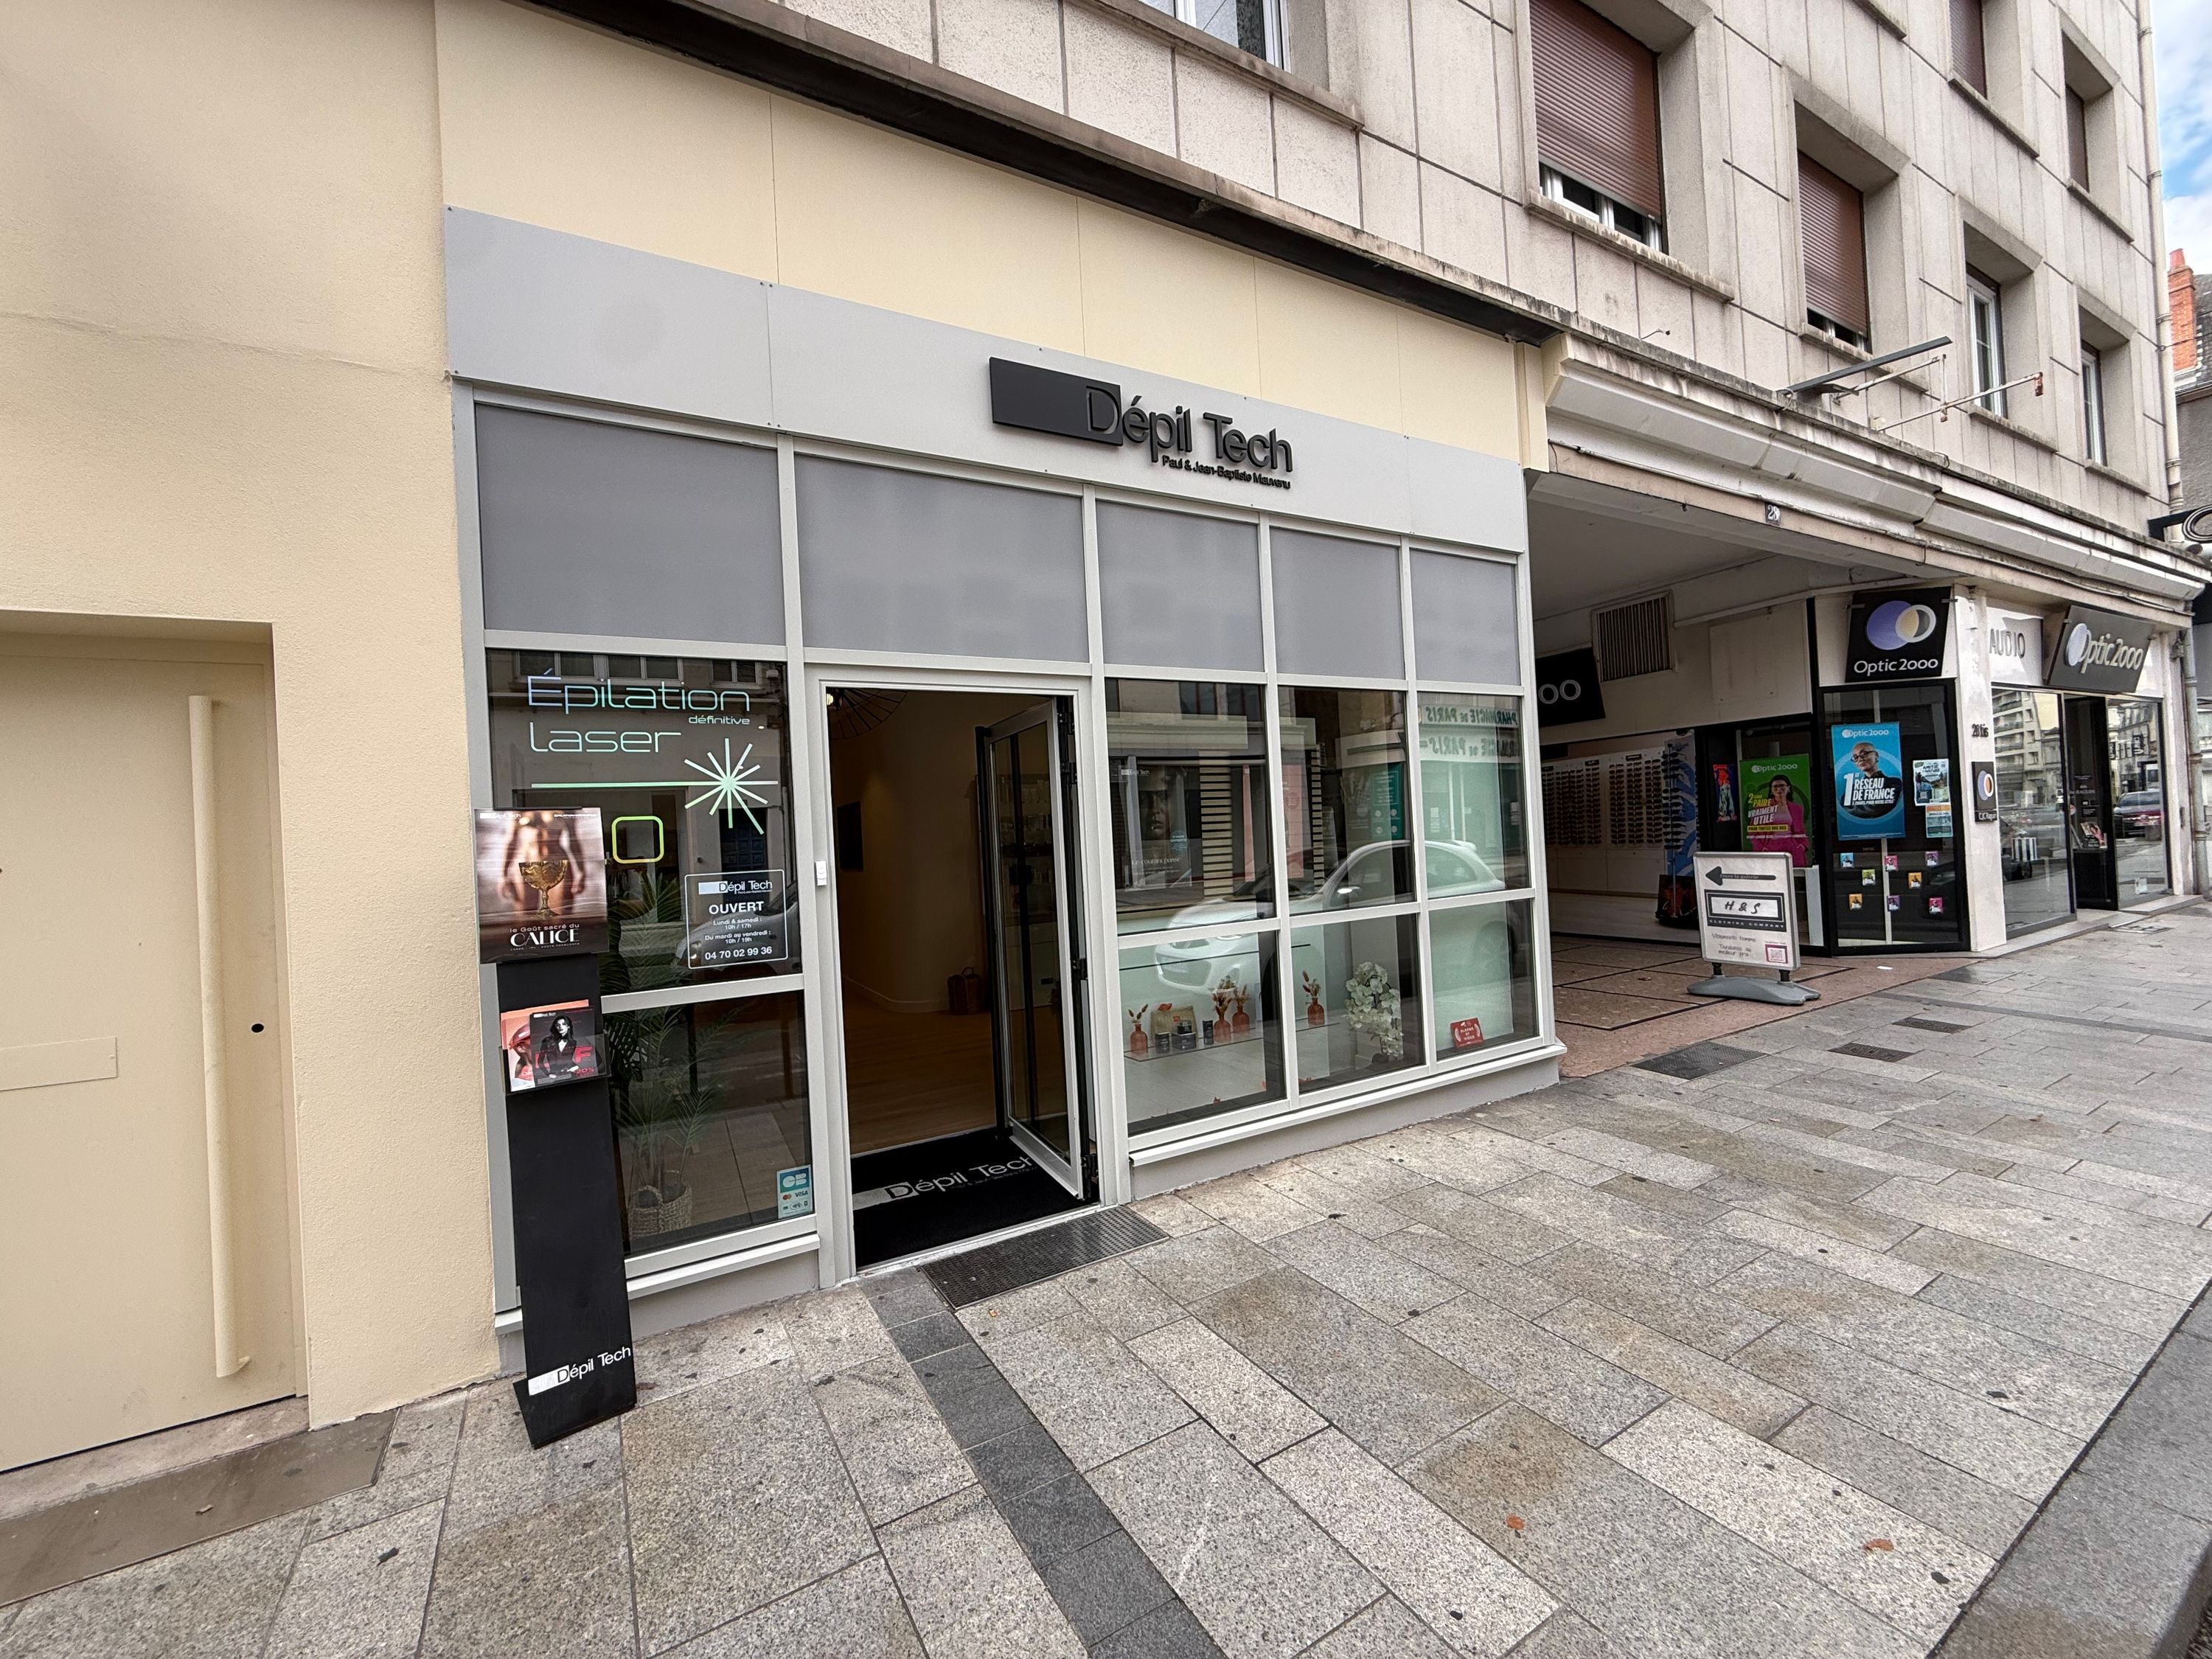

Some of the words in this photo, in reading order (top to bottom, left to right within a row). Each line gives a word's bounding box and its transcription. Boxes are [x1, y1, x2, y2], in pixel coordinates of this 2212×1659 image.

[1086, 385, 1192, 462] Dépil
[1203, 412, 1293, 473] Tech
[1162, 455, 1183, 469] Paul
[1184, 459, 1192, 470] &
[1989, 628, 2025, 658] AUDIO
[2110, 639, 2144, 670] 2000
[1854, 658, 1898, 677] Optic
[1899, 658, 1938, 670] 2000
[527, 667, 751, 714] Épilation
[688, 715, 751, 725] définitive
[1852, 790, 1863, 801] DE
[1863, 787, 1896, 800] FRANCE
[1753, 813, 1774, 825] UTILE
[719, 881, 745, 894] Dépil
[748, 880, 773, 890] Tech
[709, 901, 765, 914] OUVERT
[1725, 900, 1734, 911] H
[1739, 902, 1747, 911] &
[1750, 902, 1761, 914] S
[510, 928, 580, 947] CALICE
[705, 952, 717, 960] 04
[719, 950, 731, 959] 70
[733, 949, 745, 957] 02
[747, 947, 759, 956] 99
[760, 946, 773, 955] 36
[885, 1172, 968, 1200] Dépil
[557, 1358, 594, 1383] Dépil
[597, 1346, 631, 1366] Tech
